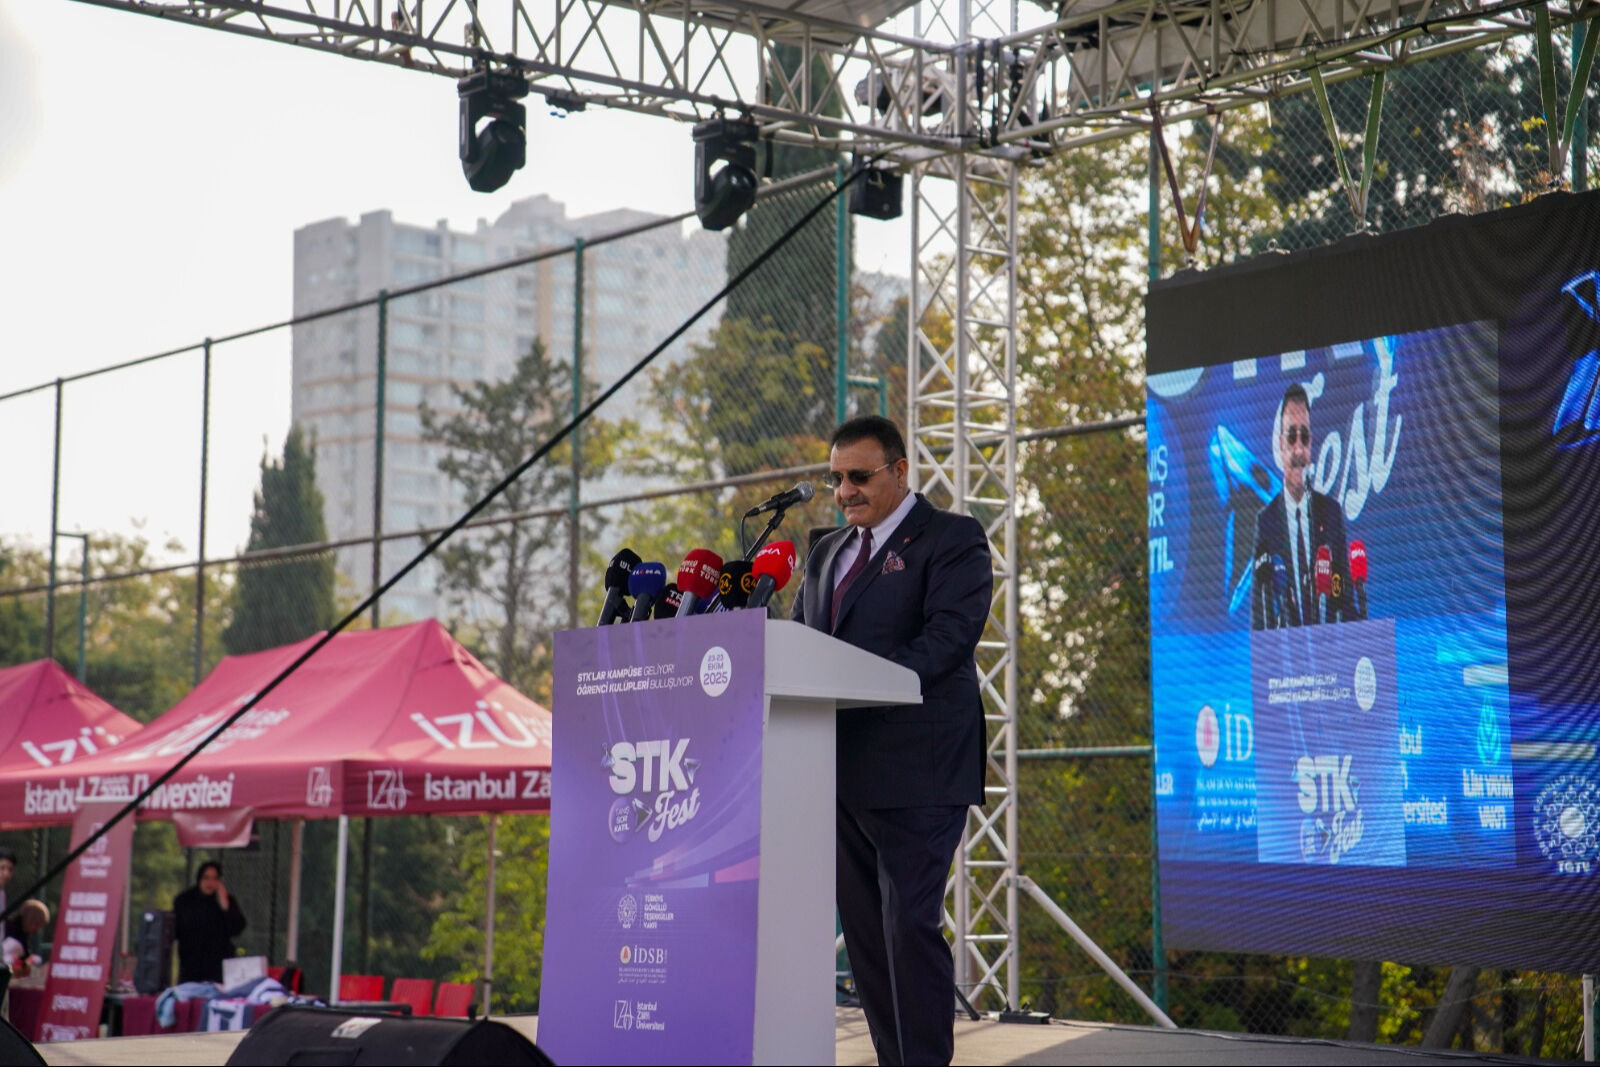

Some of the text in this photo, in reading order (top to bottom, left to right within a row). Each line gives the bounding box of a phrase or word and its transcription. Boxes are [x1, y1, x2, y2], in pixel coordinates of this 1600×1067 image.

[606, 665, 643, 679] KAMPÜSE
[703, 671, 728, 686] 2025
[576, 682, 609, 696] ÖĞRENCİ
[608, 679, 650, 693] KULÜPLERİ
[609, 738, 691, 795] STK
[1297, 754, 1357, 815] STK
[648, 788, 701, 843] Fest
[633, 944, 665, 965] İDSB
